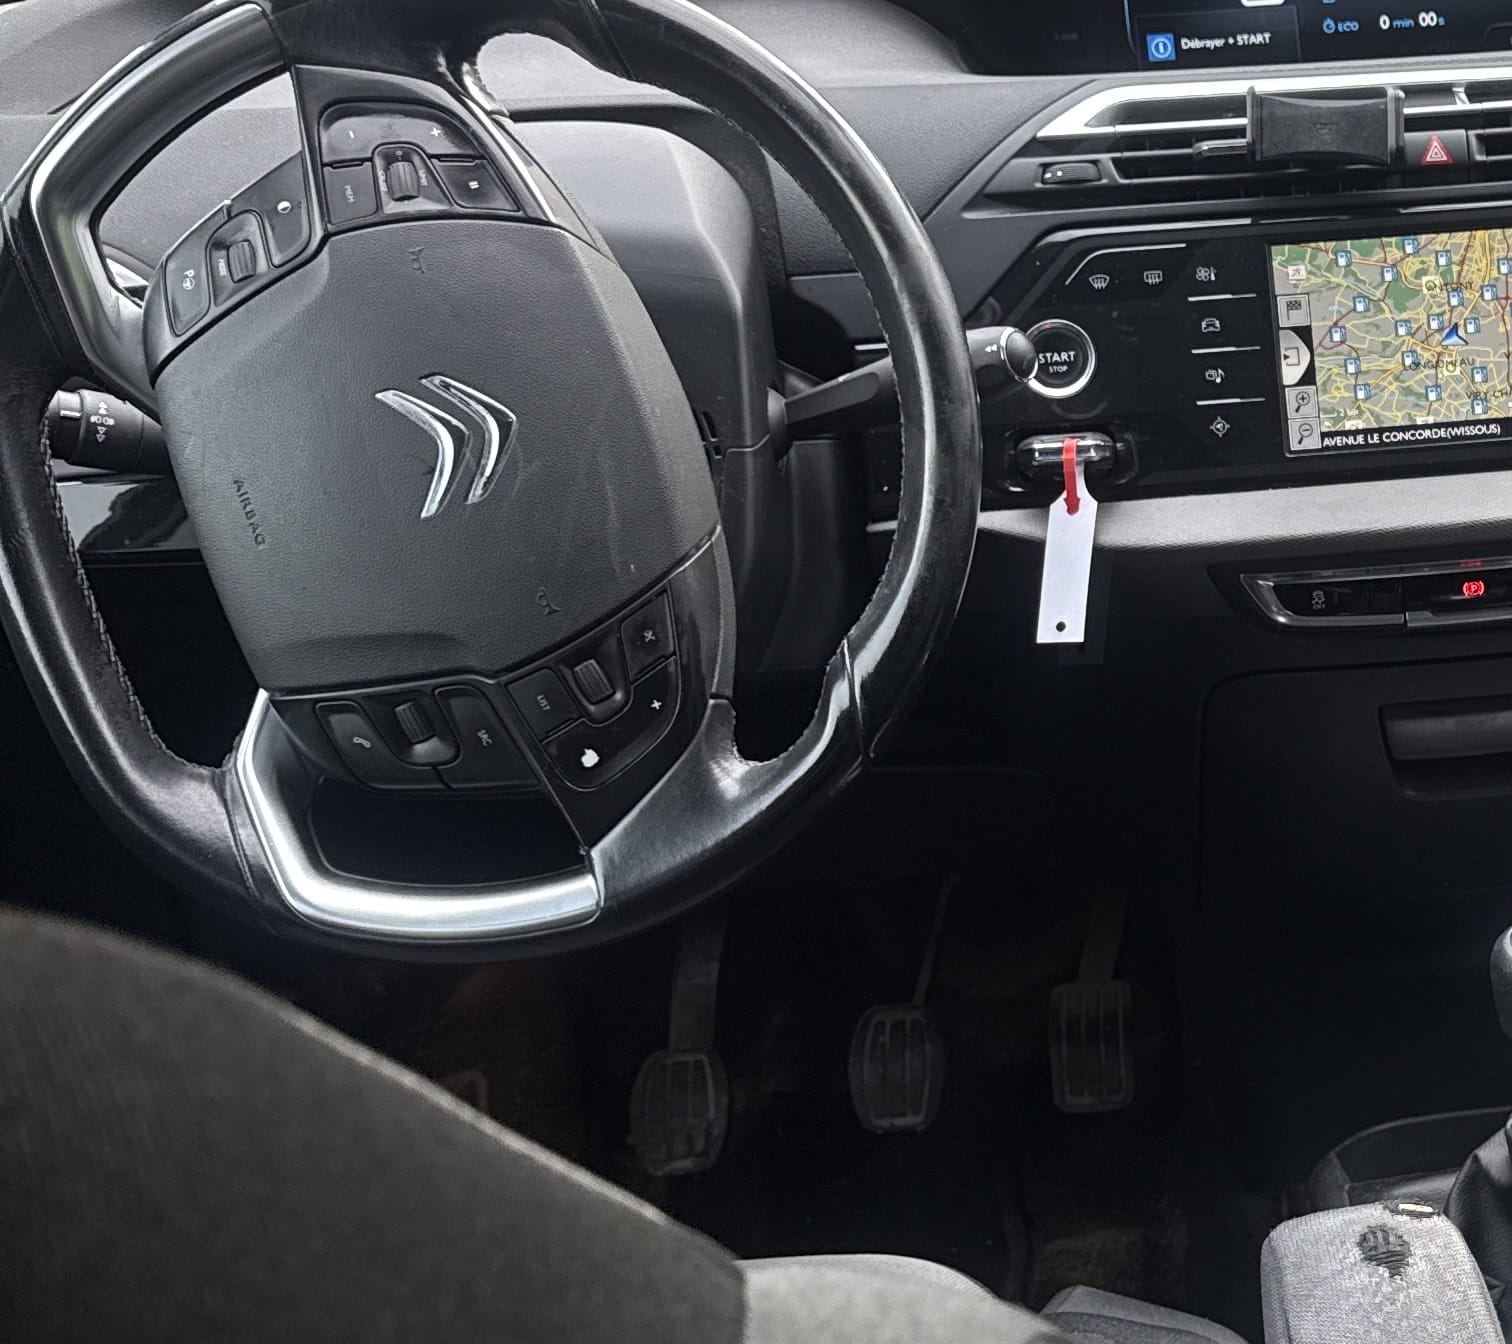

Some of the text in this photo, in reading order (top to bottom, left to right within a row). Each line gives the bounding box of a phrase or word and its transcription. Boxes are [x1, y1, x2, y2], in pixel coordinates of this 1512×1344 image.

[1236, 31, 1272, 46] START
[1038, 350, 1076, 364] START
[1048, 364, 1069, 374] STOP
[1323, 435, 1365, 448] AVENUE
[1368, 433, 1380, 445] LE
[233, 480, 266, 546] AIRBAG
